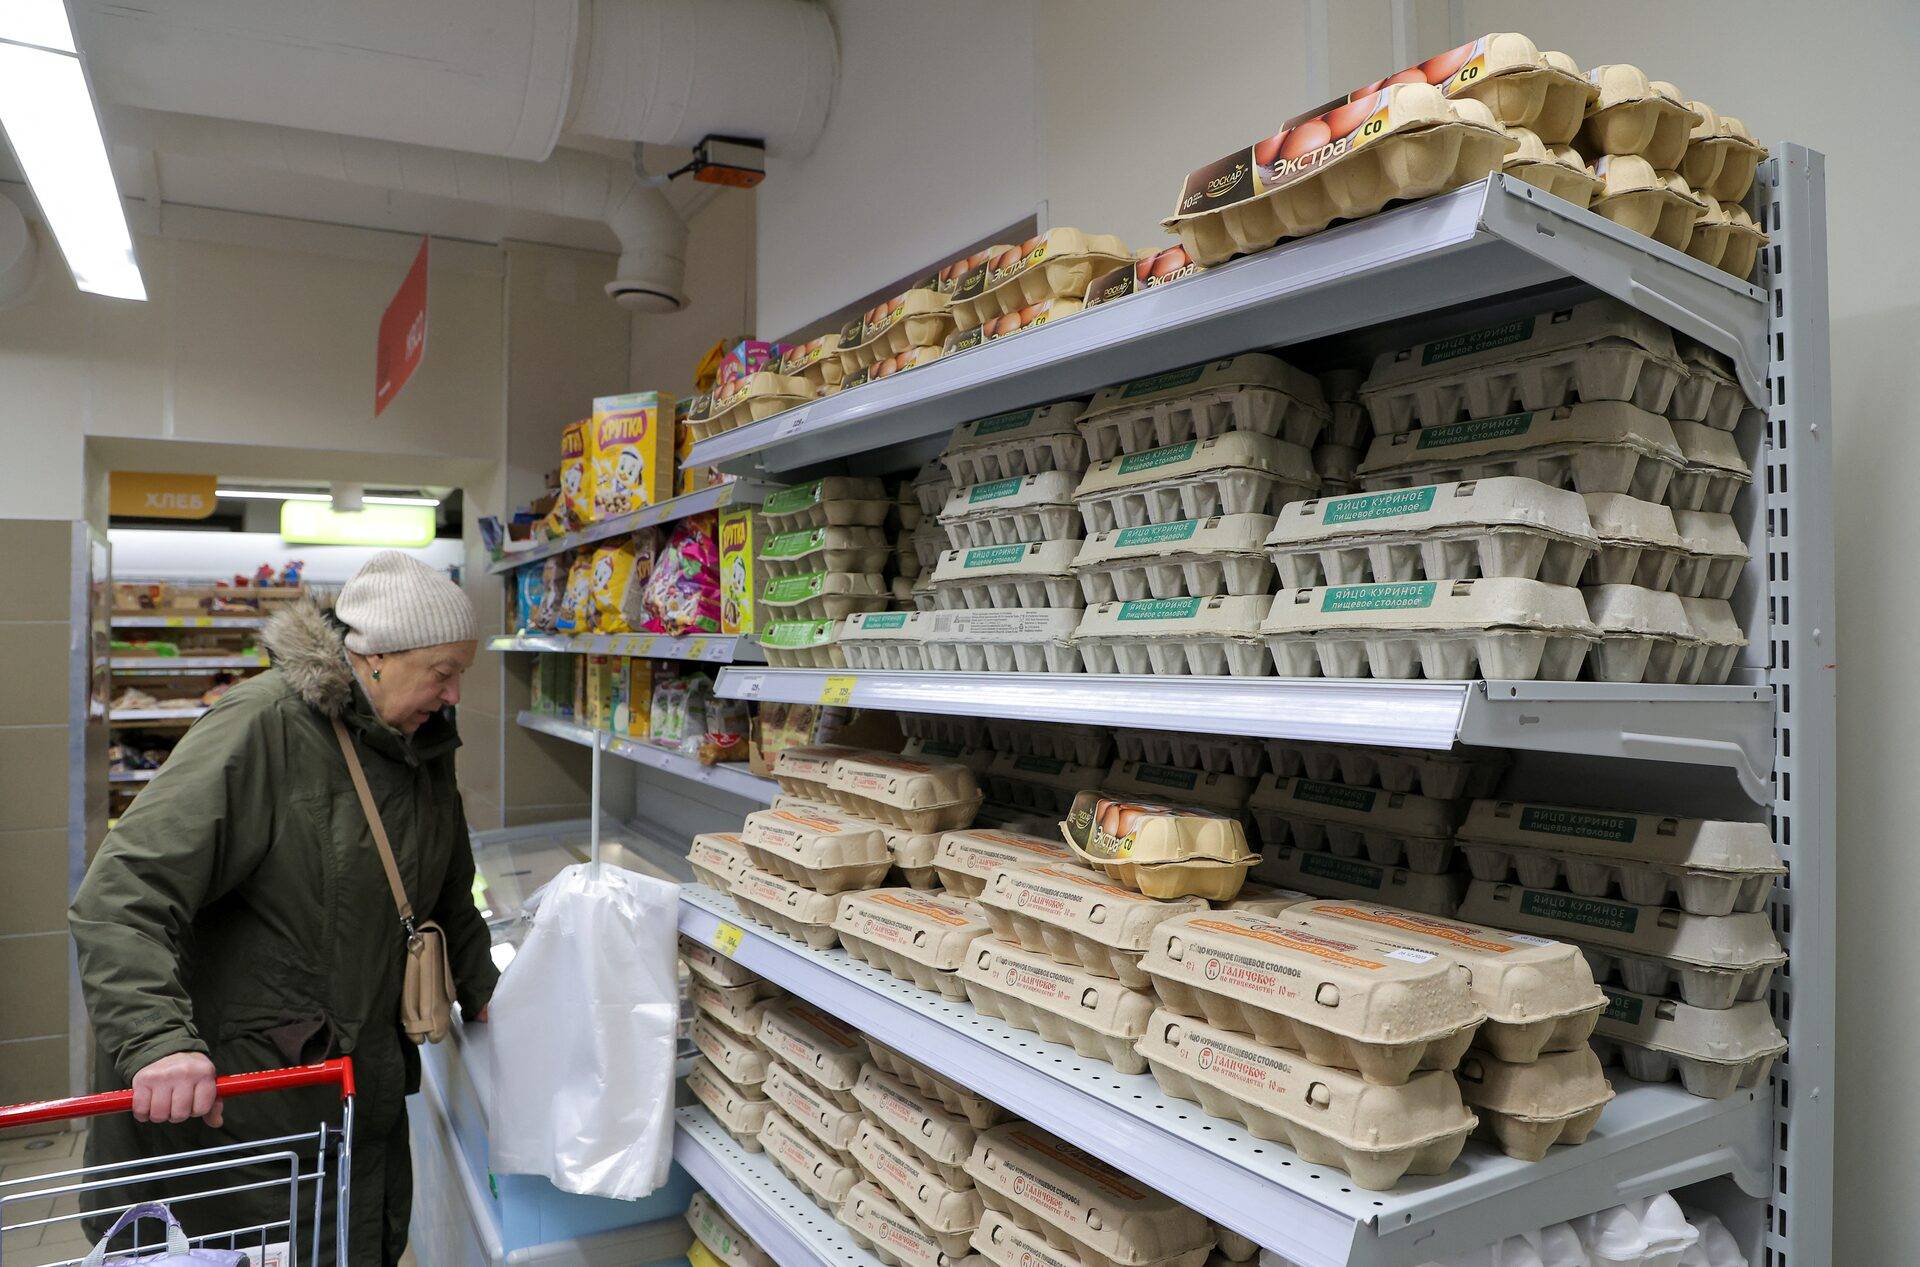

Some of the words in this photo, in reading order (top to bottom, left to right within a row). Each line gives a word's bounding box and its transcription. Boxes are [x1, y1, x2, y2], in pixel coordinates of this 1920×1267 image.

[1208, 170, 1242, 189] РОСКАР
[1470, 321, 1524, 343] КУРИНОЕ
[1467, 417, 1521, 433] КУРИНОЕ
[145, 492, 203, 509] ХЛЕБ
[1336, 499, 1367, 512] ЯЙЦО
[1371, 491, 1423, 507] КУРИНОЕ
[1333, 510, 1373, 522] пищевое
[1377, 503, 1419, 516] столовое
[1127, 528, 1149, 538] ЯЙЦО
[1151, 523, 1189, 534] КУРИНОЕ
[1334, 588, 1366, 600] ЯЙЦО
[1370, 585, 1423, 597] КУРИНОЕ
[1129, 602, 1153, 611] ЯЙЦО
[1155, 600, 1192, 609] КУРИНОЕ
[1332, 600, 1372, 610] пищевое
[1375, 597, 1421, 608] столовое
[1569, 815, 1625, 829] КУРИНОЕ
[1570, 899, 1625, 918] КУРИНОЕ
[1206, 948, 1234, 962] КУРИНОЕ
[1234, 954, 1265, 968] ПИЩЕВОЕ
[1265, 962, 1302, 978] СТОЛОВОЕ
[1222, 964, 1277, 987] ГАЛИЧСКОЕ
[1278, 985, 1287, 996] 10
[1214, 1055, 1267, 1080] ГАЛИЧСКОЕ
[1226, 1045, 1257, 1062] ПИЩЕВОЕ
[1257, 1055, 1292, 1074] СТОЛОВОЕ
[1055, 1188, 1080, 1206] СТОЛОВОЕ
